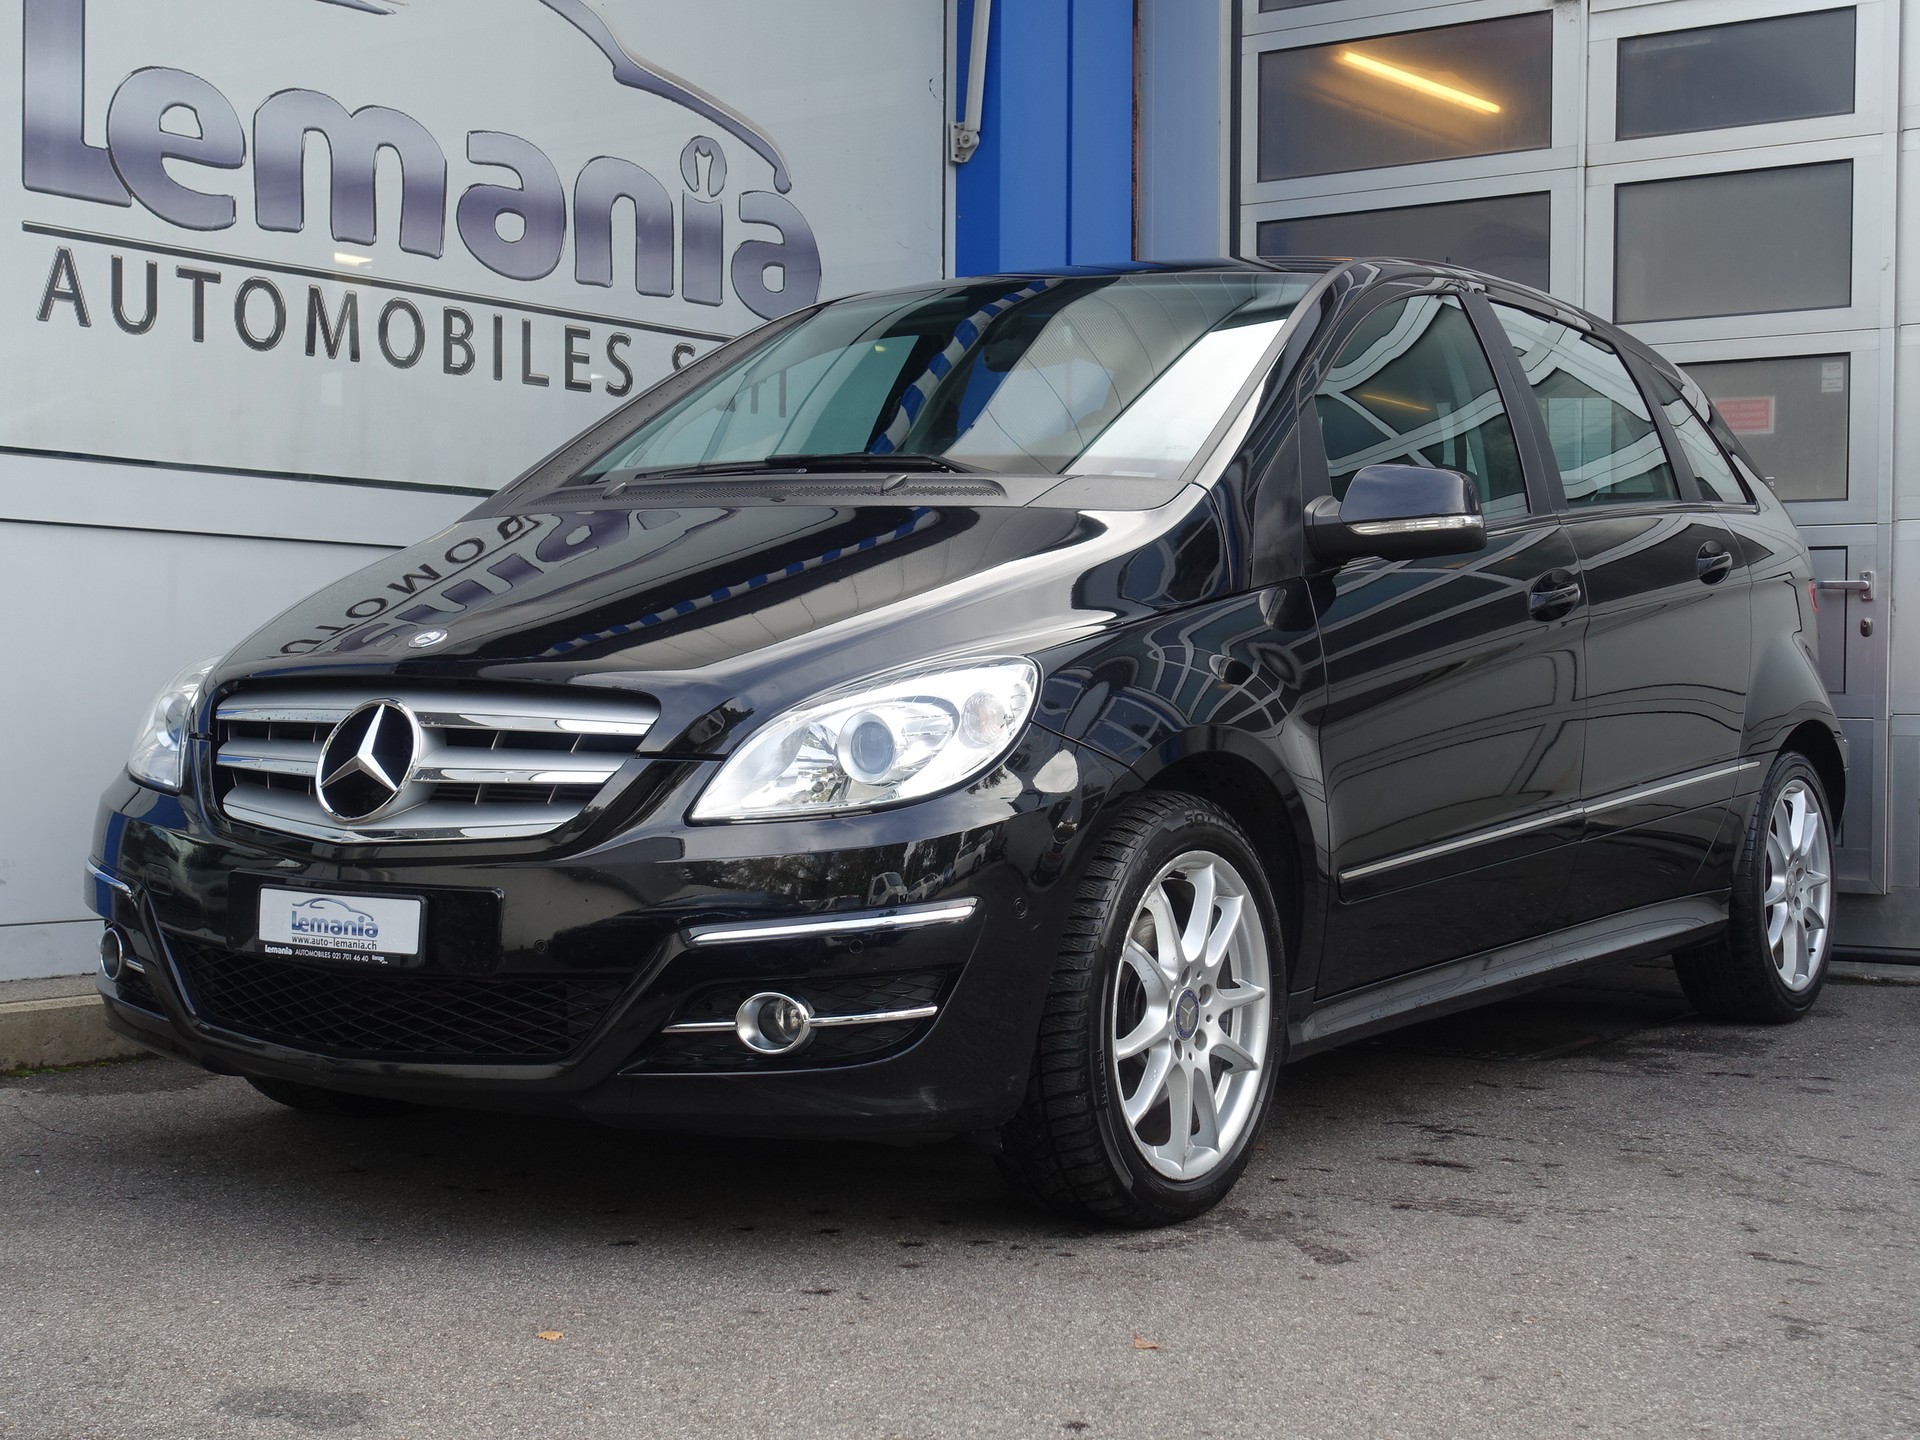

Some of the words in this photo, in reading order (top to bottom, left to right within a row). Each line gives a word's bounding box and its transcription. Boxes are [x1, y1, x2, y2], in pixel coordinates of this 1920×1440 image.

[22, 0, 822, 320] Lemania
[36, 246, 635, 397] AUTOMOBILES
[291, 911, 379, 939] Lemania
[264, 944, 293, 956] Lemania
[295, 948, 331, 959] AUTOMOBILES
[343, 953, 352, 961] 701
[353, 954, 361, 962] 46
[291, 936, 377, 951] www.auto-lemania.ch
